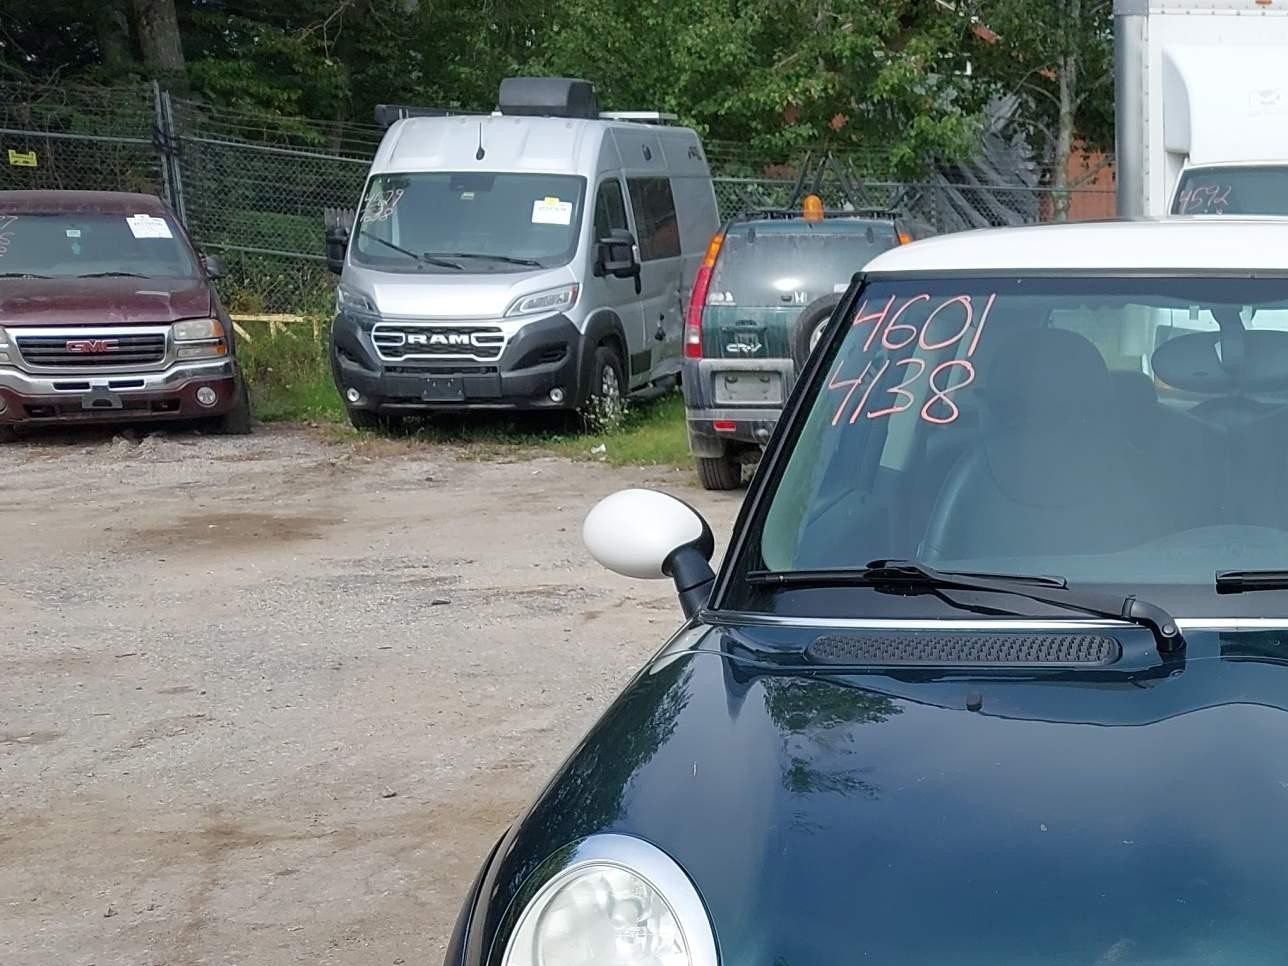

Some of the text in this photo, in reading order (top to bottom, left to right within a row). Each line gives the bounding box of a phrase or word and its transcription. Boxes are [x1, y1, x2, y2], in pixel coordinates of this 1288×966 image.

[407, 333, 472, 345] RAM
[852, 292, 997, 357] 4601
[66, 339, 120, 352] GMC
[828, 358, 975, 426] 4138
